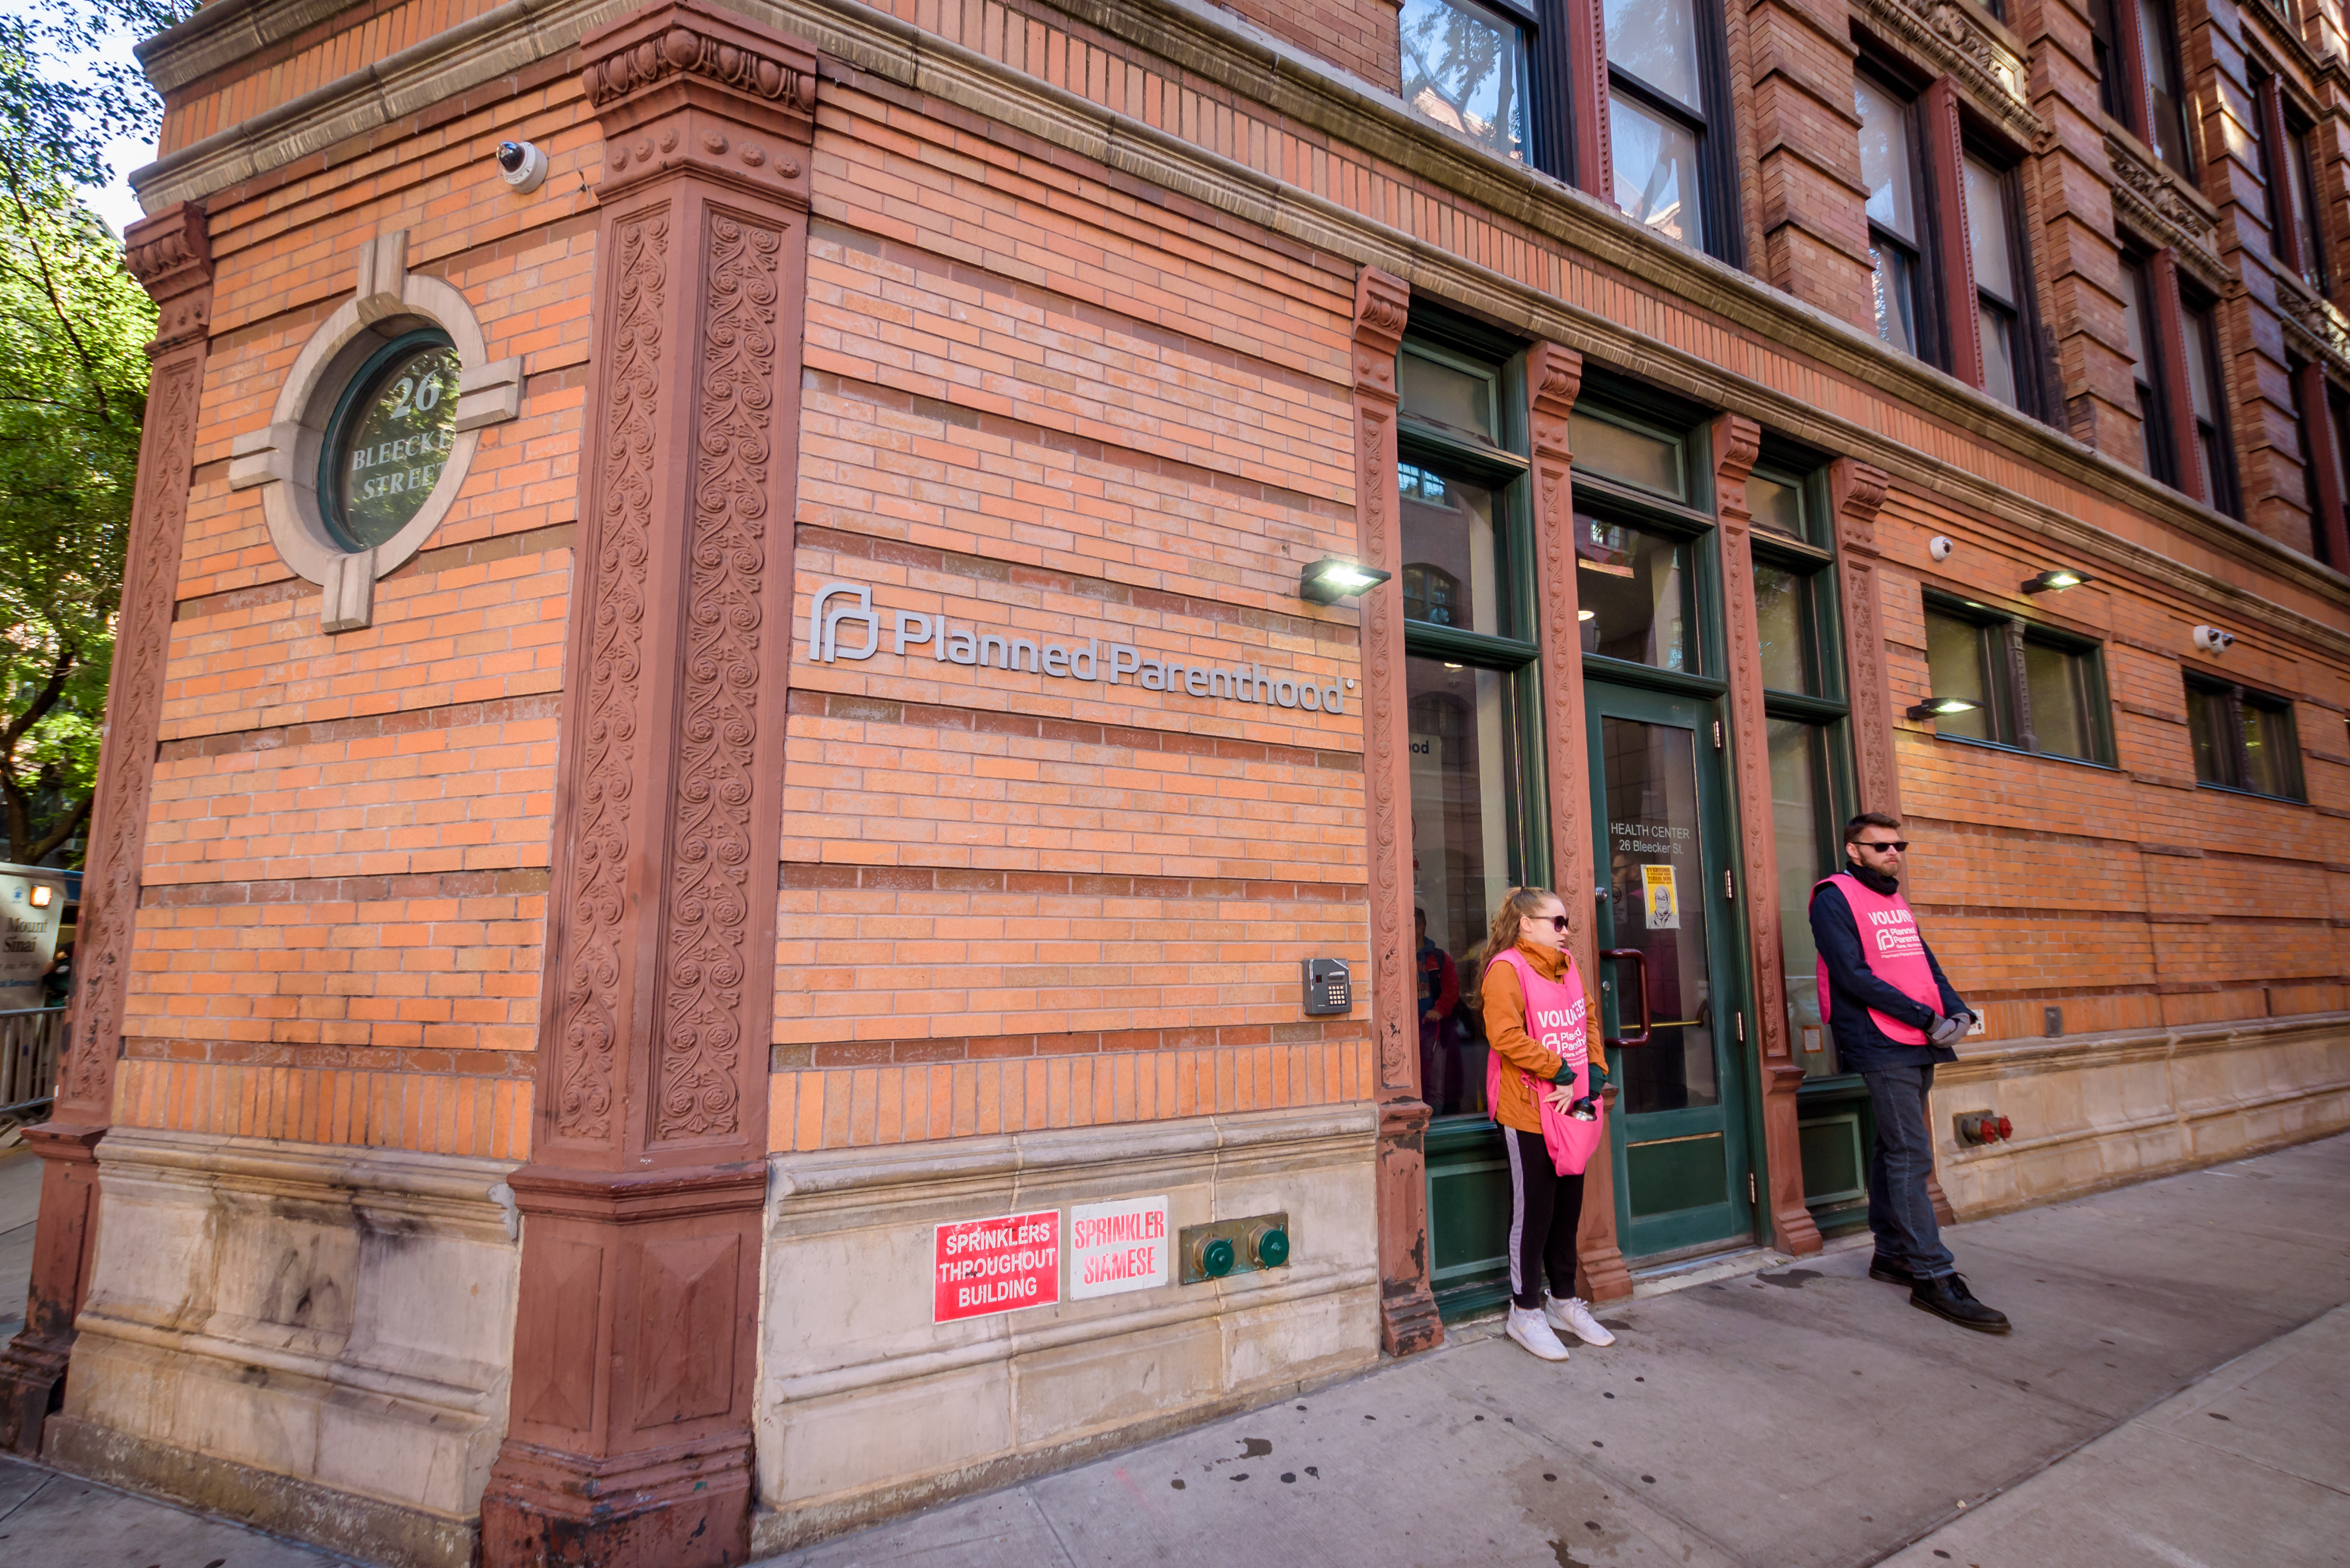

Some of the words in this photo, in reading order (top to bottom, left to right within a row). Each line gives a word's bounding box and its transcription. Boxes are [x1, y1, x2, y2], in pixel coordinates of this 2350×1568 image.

[389, 368, 440, 421] 26
[351, 428, 456, 471] BLEECKE
[895, 609, 1098, 681] Planned
[1109, 642, 1343, 715] Parenthood
[1610, 822, 1650, 837] HEALTH
[1651, 825, 1690, 840] CENTER
[1619, 839, 1631, 851] 26
[1633, 840, 1670, 853] Bleecker
[1672, 843, 1684, 854] St.
[5, 917, 49, 933] Mount
[3, 936, 36, 953] Sinai
[945, 1223, 1050, 1255] SPRINKLERS
[1074, 1210, 1164, 1250] SPRINKLER
[939, 1247, 1056, 1283] THROUGHOUT
[1083, 1245, 1156, 1285] SIAMESE
[959, 1277, 1037, 1307] BUILDING
